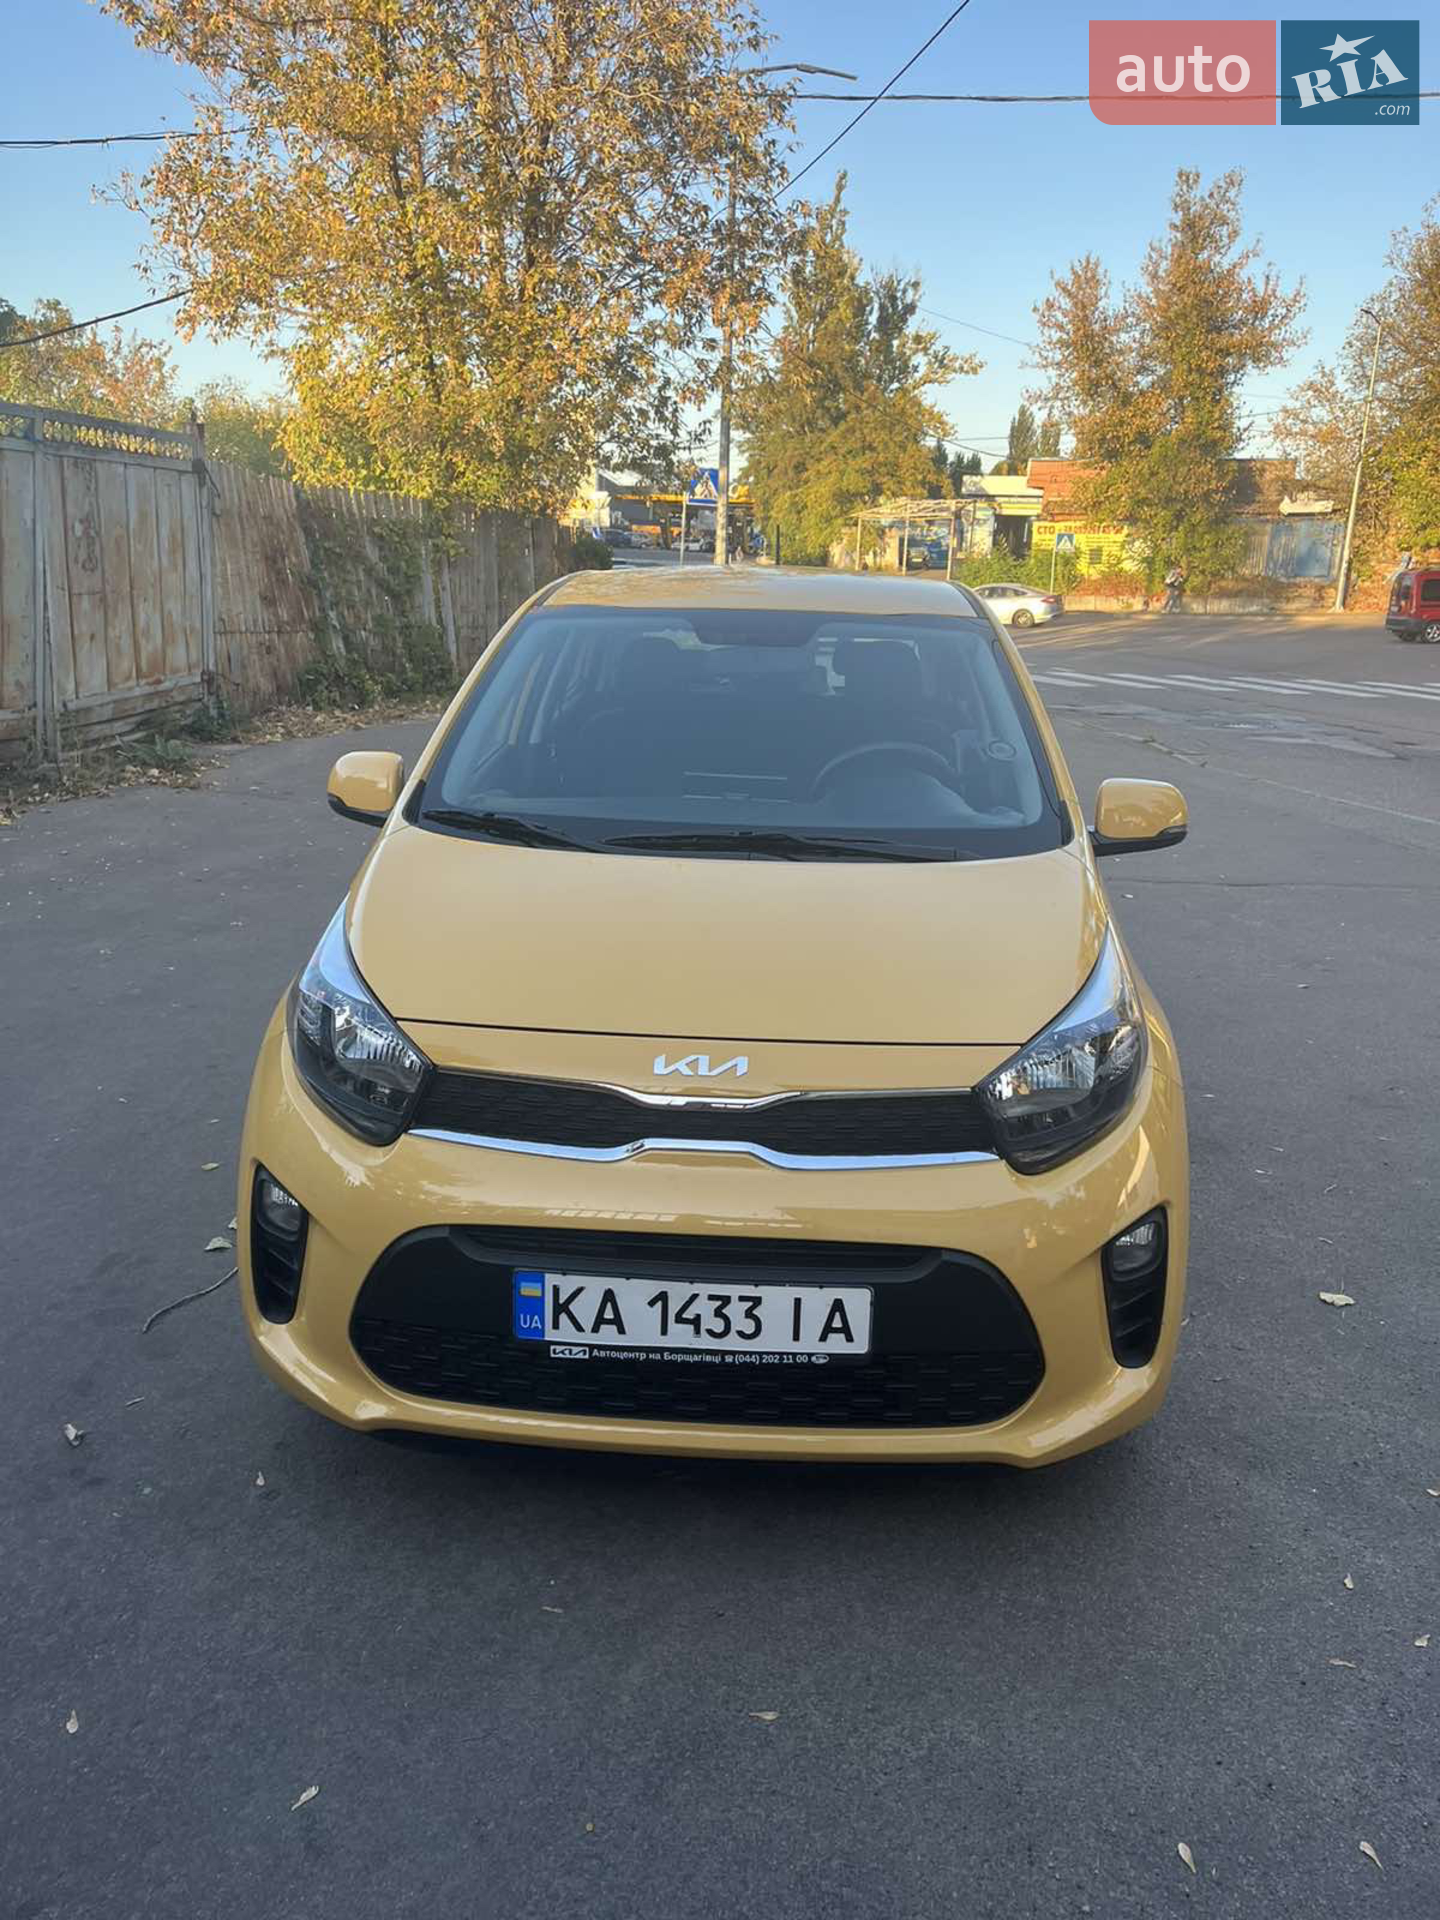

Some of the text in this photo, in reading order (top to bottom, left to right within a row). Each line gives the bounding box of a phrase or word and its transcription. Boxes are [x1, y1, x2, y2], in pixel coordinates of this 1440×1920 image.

[653, 1054, 749, 1076] KIA
[519, 1313, 542, 1330] UA
[551, 1284, 855, 1344] KA 1433 IA
[552, 1346, 588, 1358] KIA
[592, 1348, 647, 1361] Автоцентр
[649, 1352, 661, 1360] на
[663, 1351, 721, 1363] Борщагівці
[762, 1354, 780, 1363] 202
[782, 1354, 794, 1363] 11
[795, 1354, 809, 1363] 00
